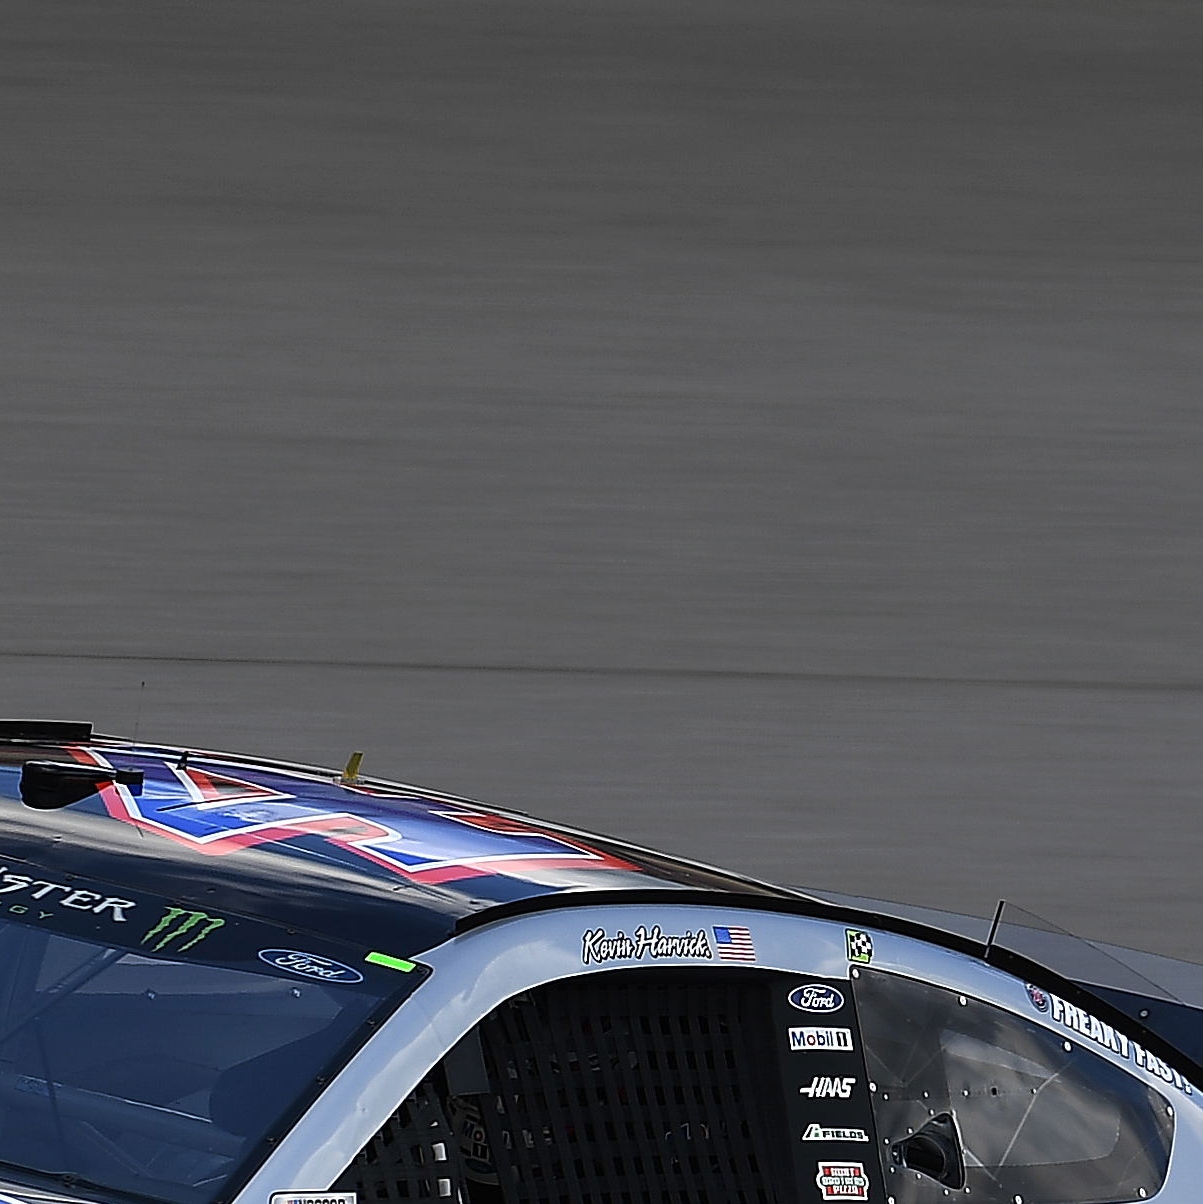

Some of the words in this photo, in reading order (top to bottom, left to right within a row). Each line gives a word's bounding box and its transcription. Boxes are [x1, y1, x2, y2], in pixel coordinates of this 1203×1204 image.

[582, 928, 634, 964] Kevin
[634, 924, 713, 959] Harvick
[275, 953, 346, 978] Ford
[800, 986, 836, 1009] Ford
[791, 1030, 834, 1047] Mobil
[799, 1076, 856, 1098] HAAS
[822, 1130, 864, 1140] FIELDS
